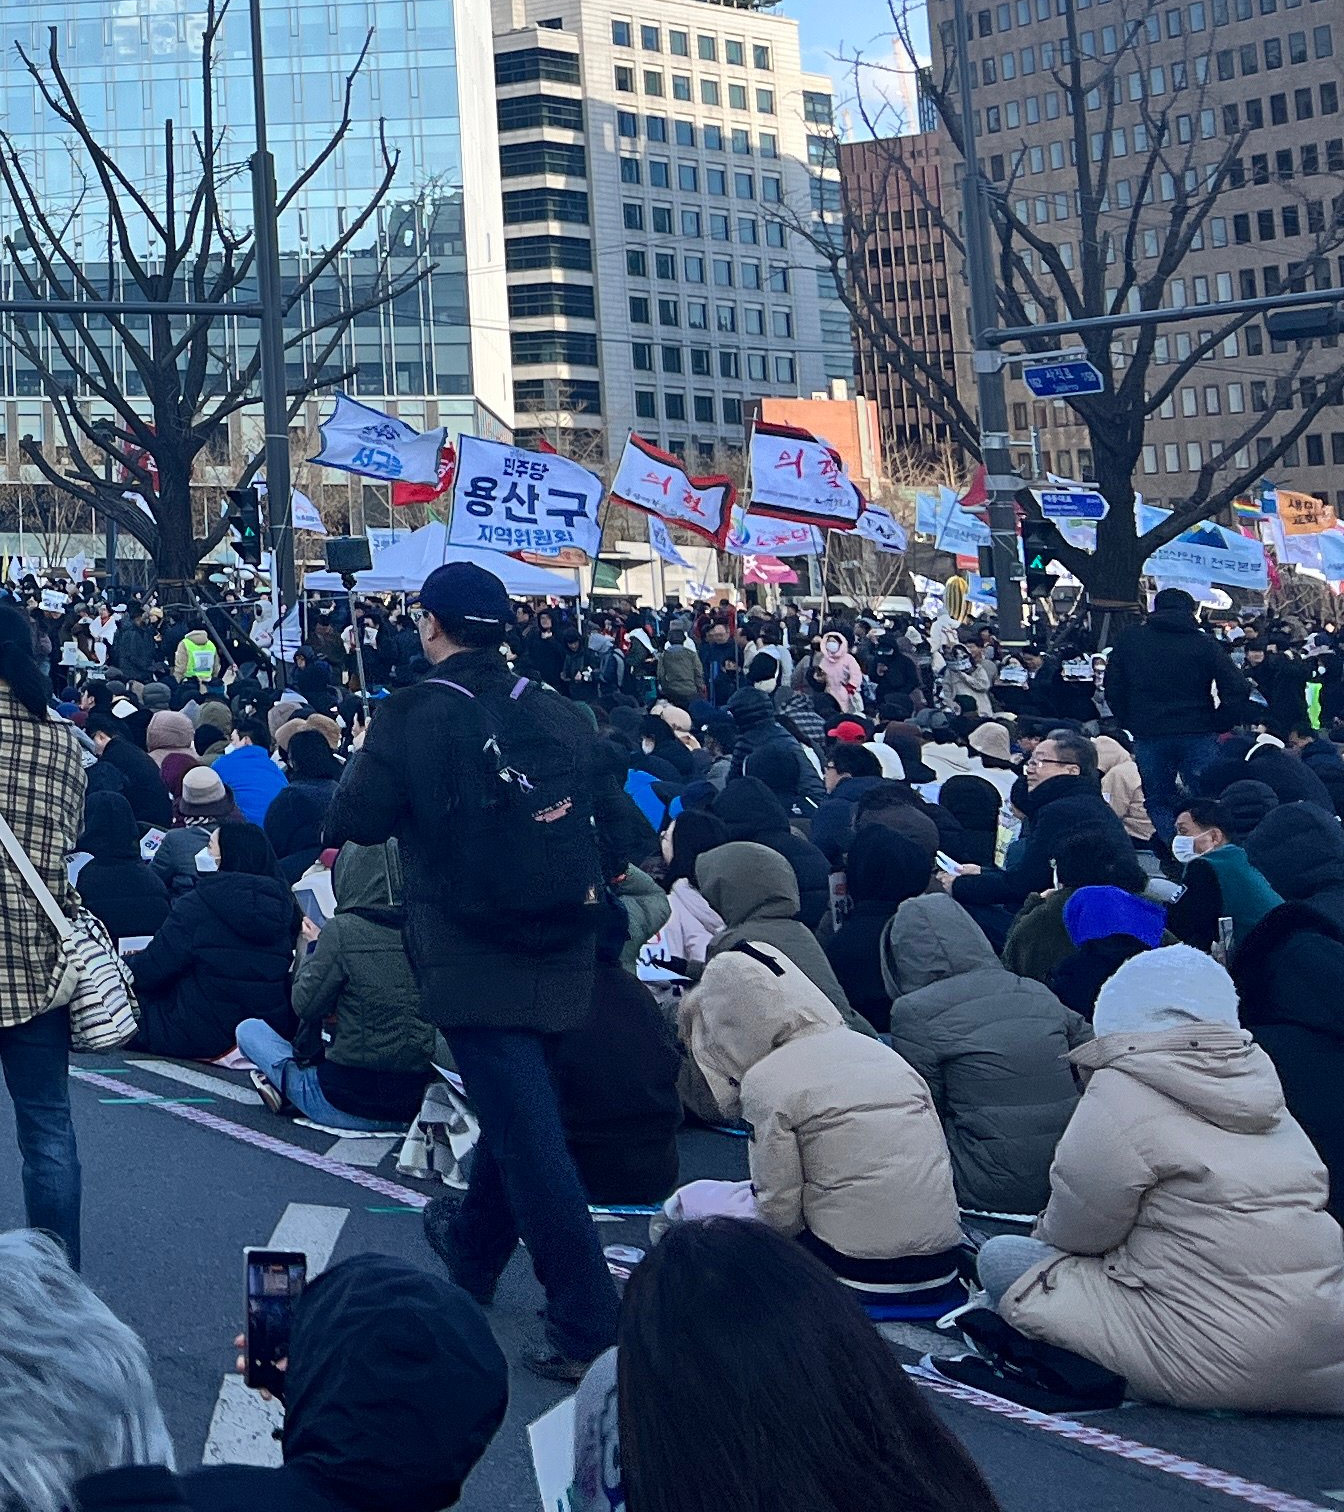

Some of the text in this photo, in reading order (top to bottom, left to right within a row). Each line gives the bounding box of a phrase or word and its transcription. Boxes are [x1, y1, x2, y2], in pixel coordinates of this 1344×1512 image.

[502, 456, 550, 482] 민주당
[463, 475, 591, 528] 용산구
[477, 524, 575, 546] 지역위원회
